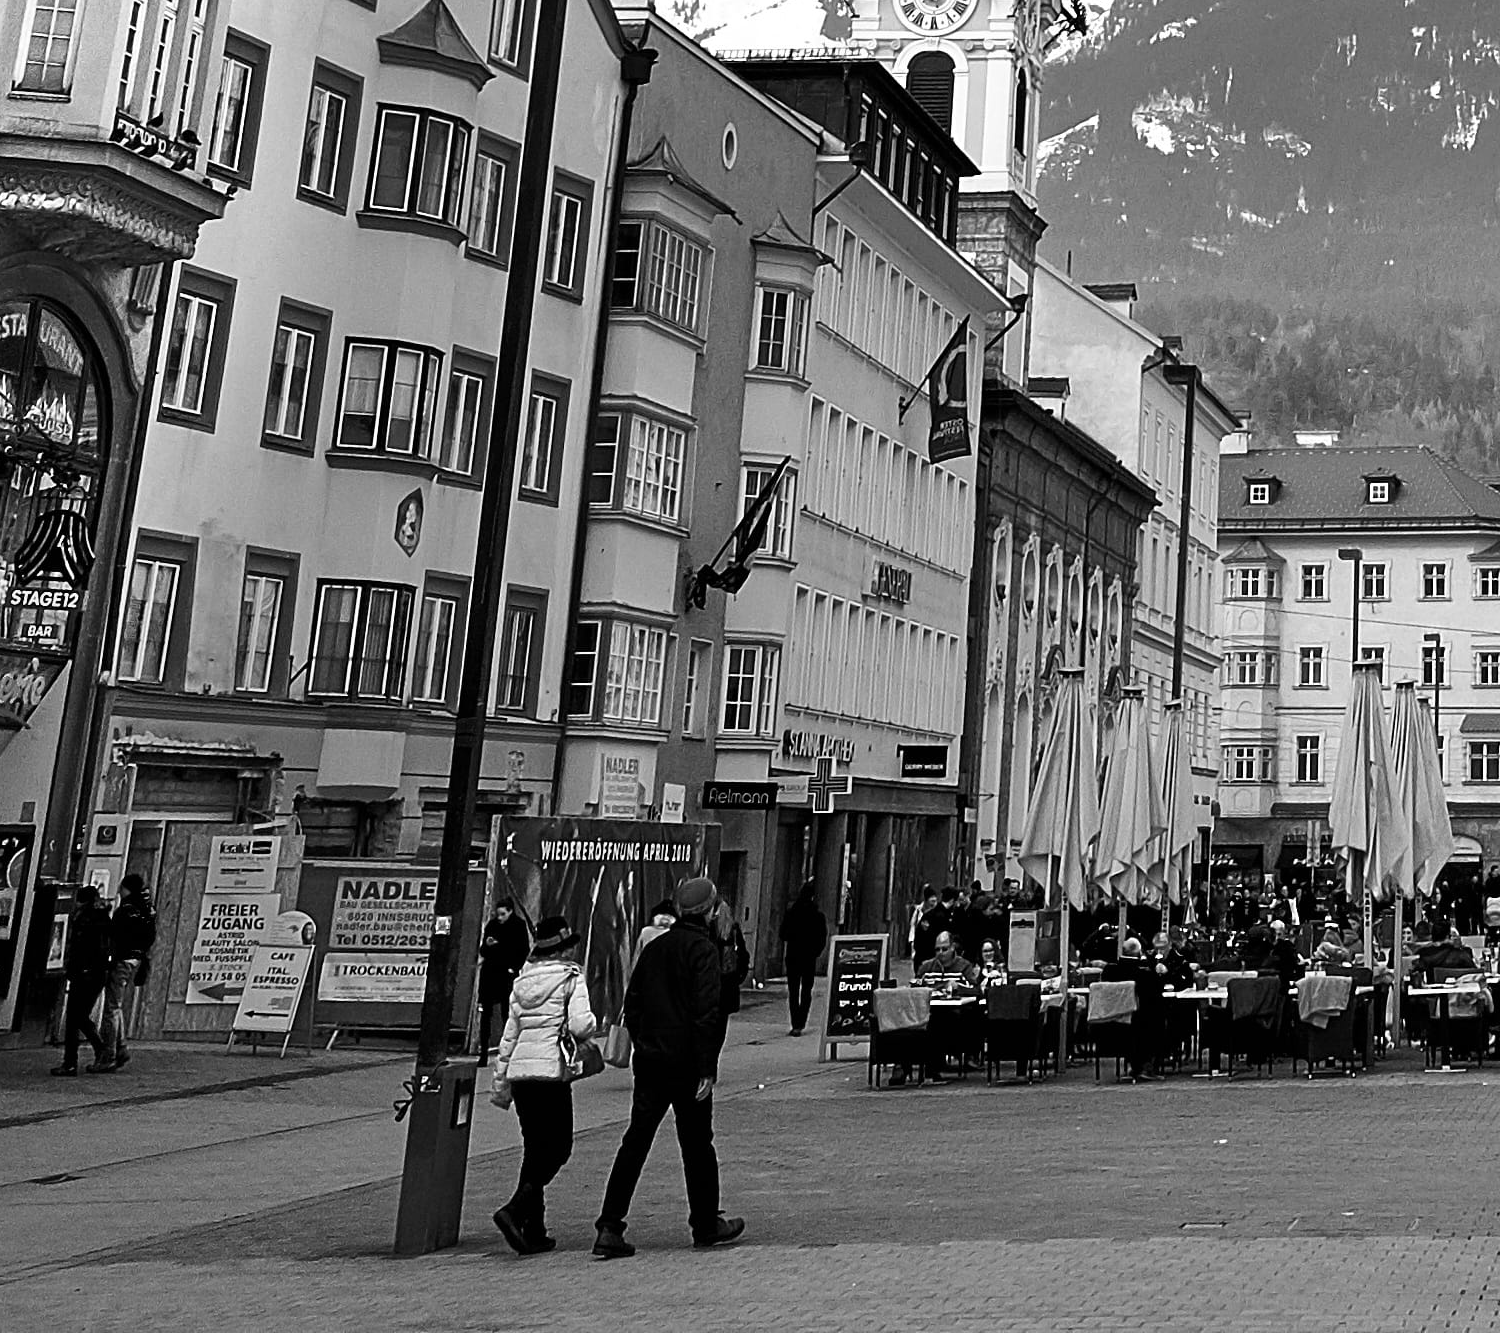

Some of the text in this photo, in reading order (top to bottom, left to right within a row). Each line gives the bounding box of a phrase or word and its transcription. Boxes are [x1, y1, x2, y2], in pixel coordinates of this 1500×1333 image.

[10, 589, 80, 608] STAGE12
[27, 624, 53, 638] BAR
[606, 756, 639, 775] NADLER
[541, 838, 691, 862] WIEDERERÖFFNUNG APRIL 2018
[210, 904, 259, 917] FREIER
[202, 918, 264, 931] ZUGANG
[336, 935, 356, 946] Tel
[271, 953, 295, 961] CAFE
[190, 973, 212, 981] 0512
[342, 966, 426, 976] TROCKENBAU
[252, 976, 299, 984] ESPRESSO
[839, 981, 872, 992] Brunch
